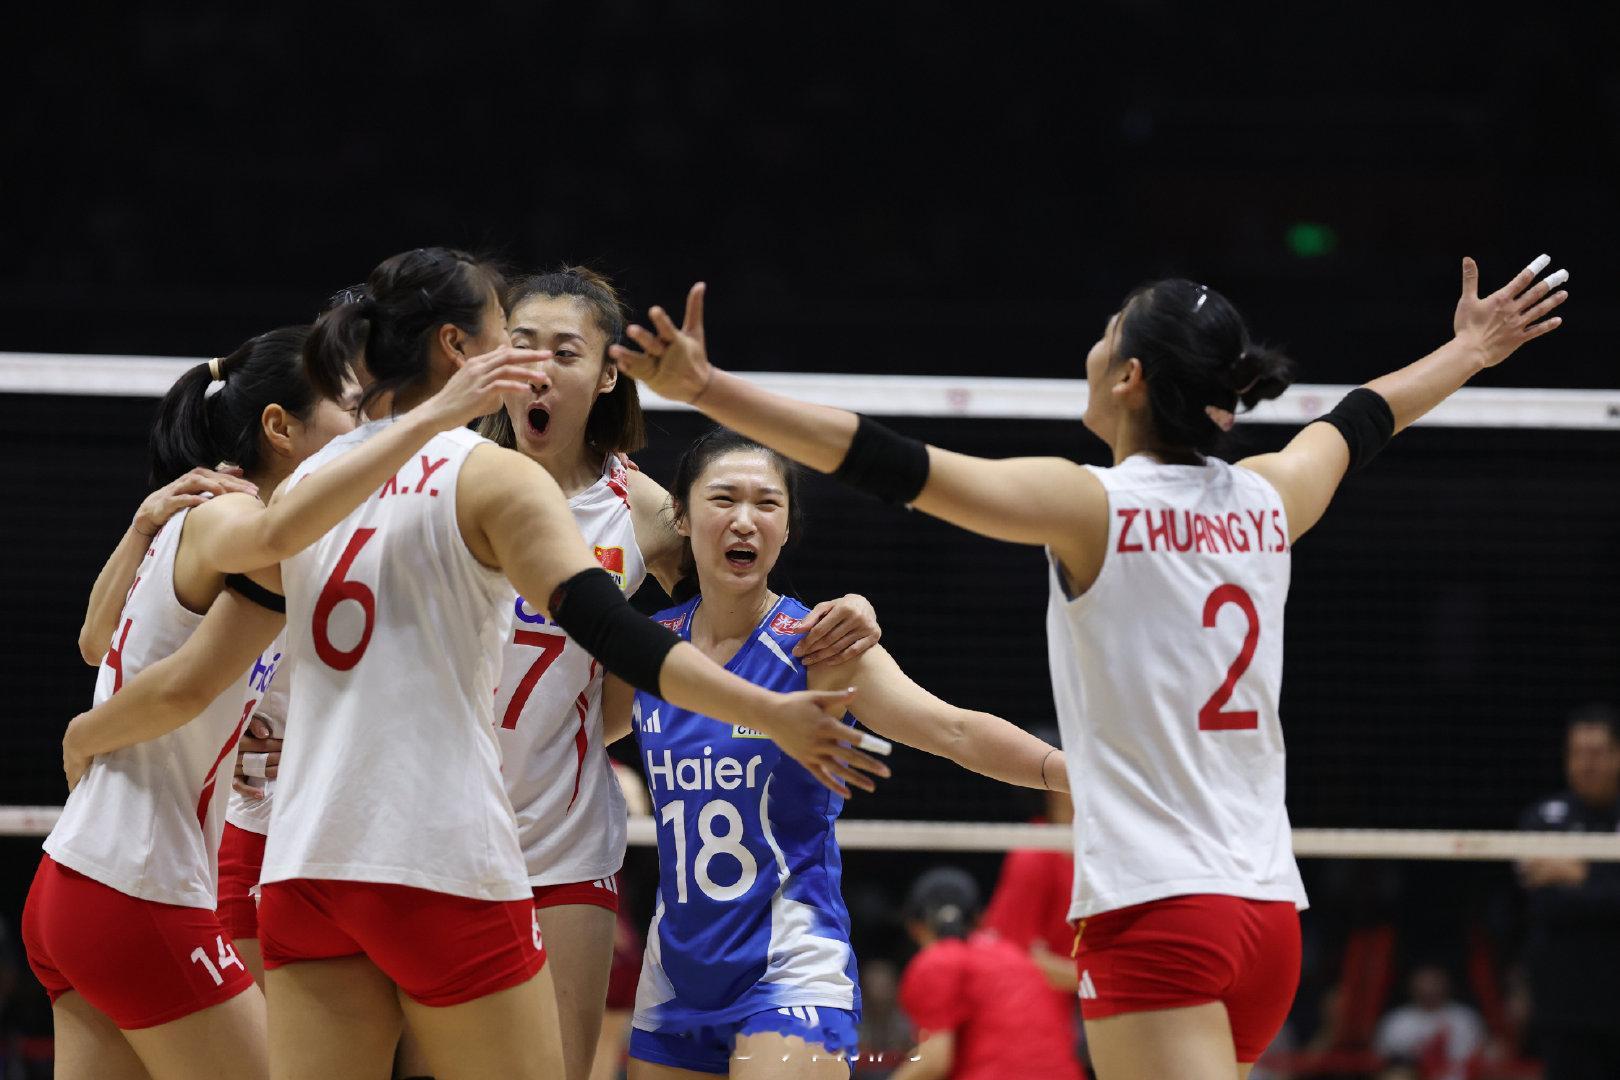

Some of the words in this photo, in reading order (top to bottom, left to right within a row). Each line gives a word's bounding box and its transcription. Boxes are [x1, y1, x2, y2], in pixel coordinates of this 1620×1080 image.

[312, 528, 375, 672] 6
[501, 628, 567, 730] 7
[1198, 583, 1260, 731] 2
[647, 745, 763, 791] Haier
[661, 799, 758, 904] 18
[190, 935, 245, 986] 14
